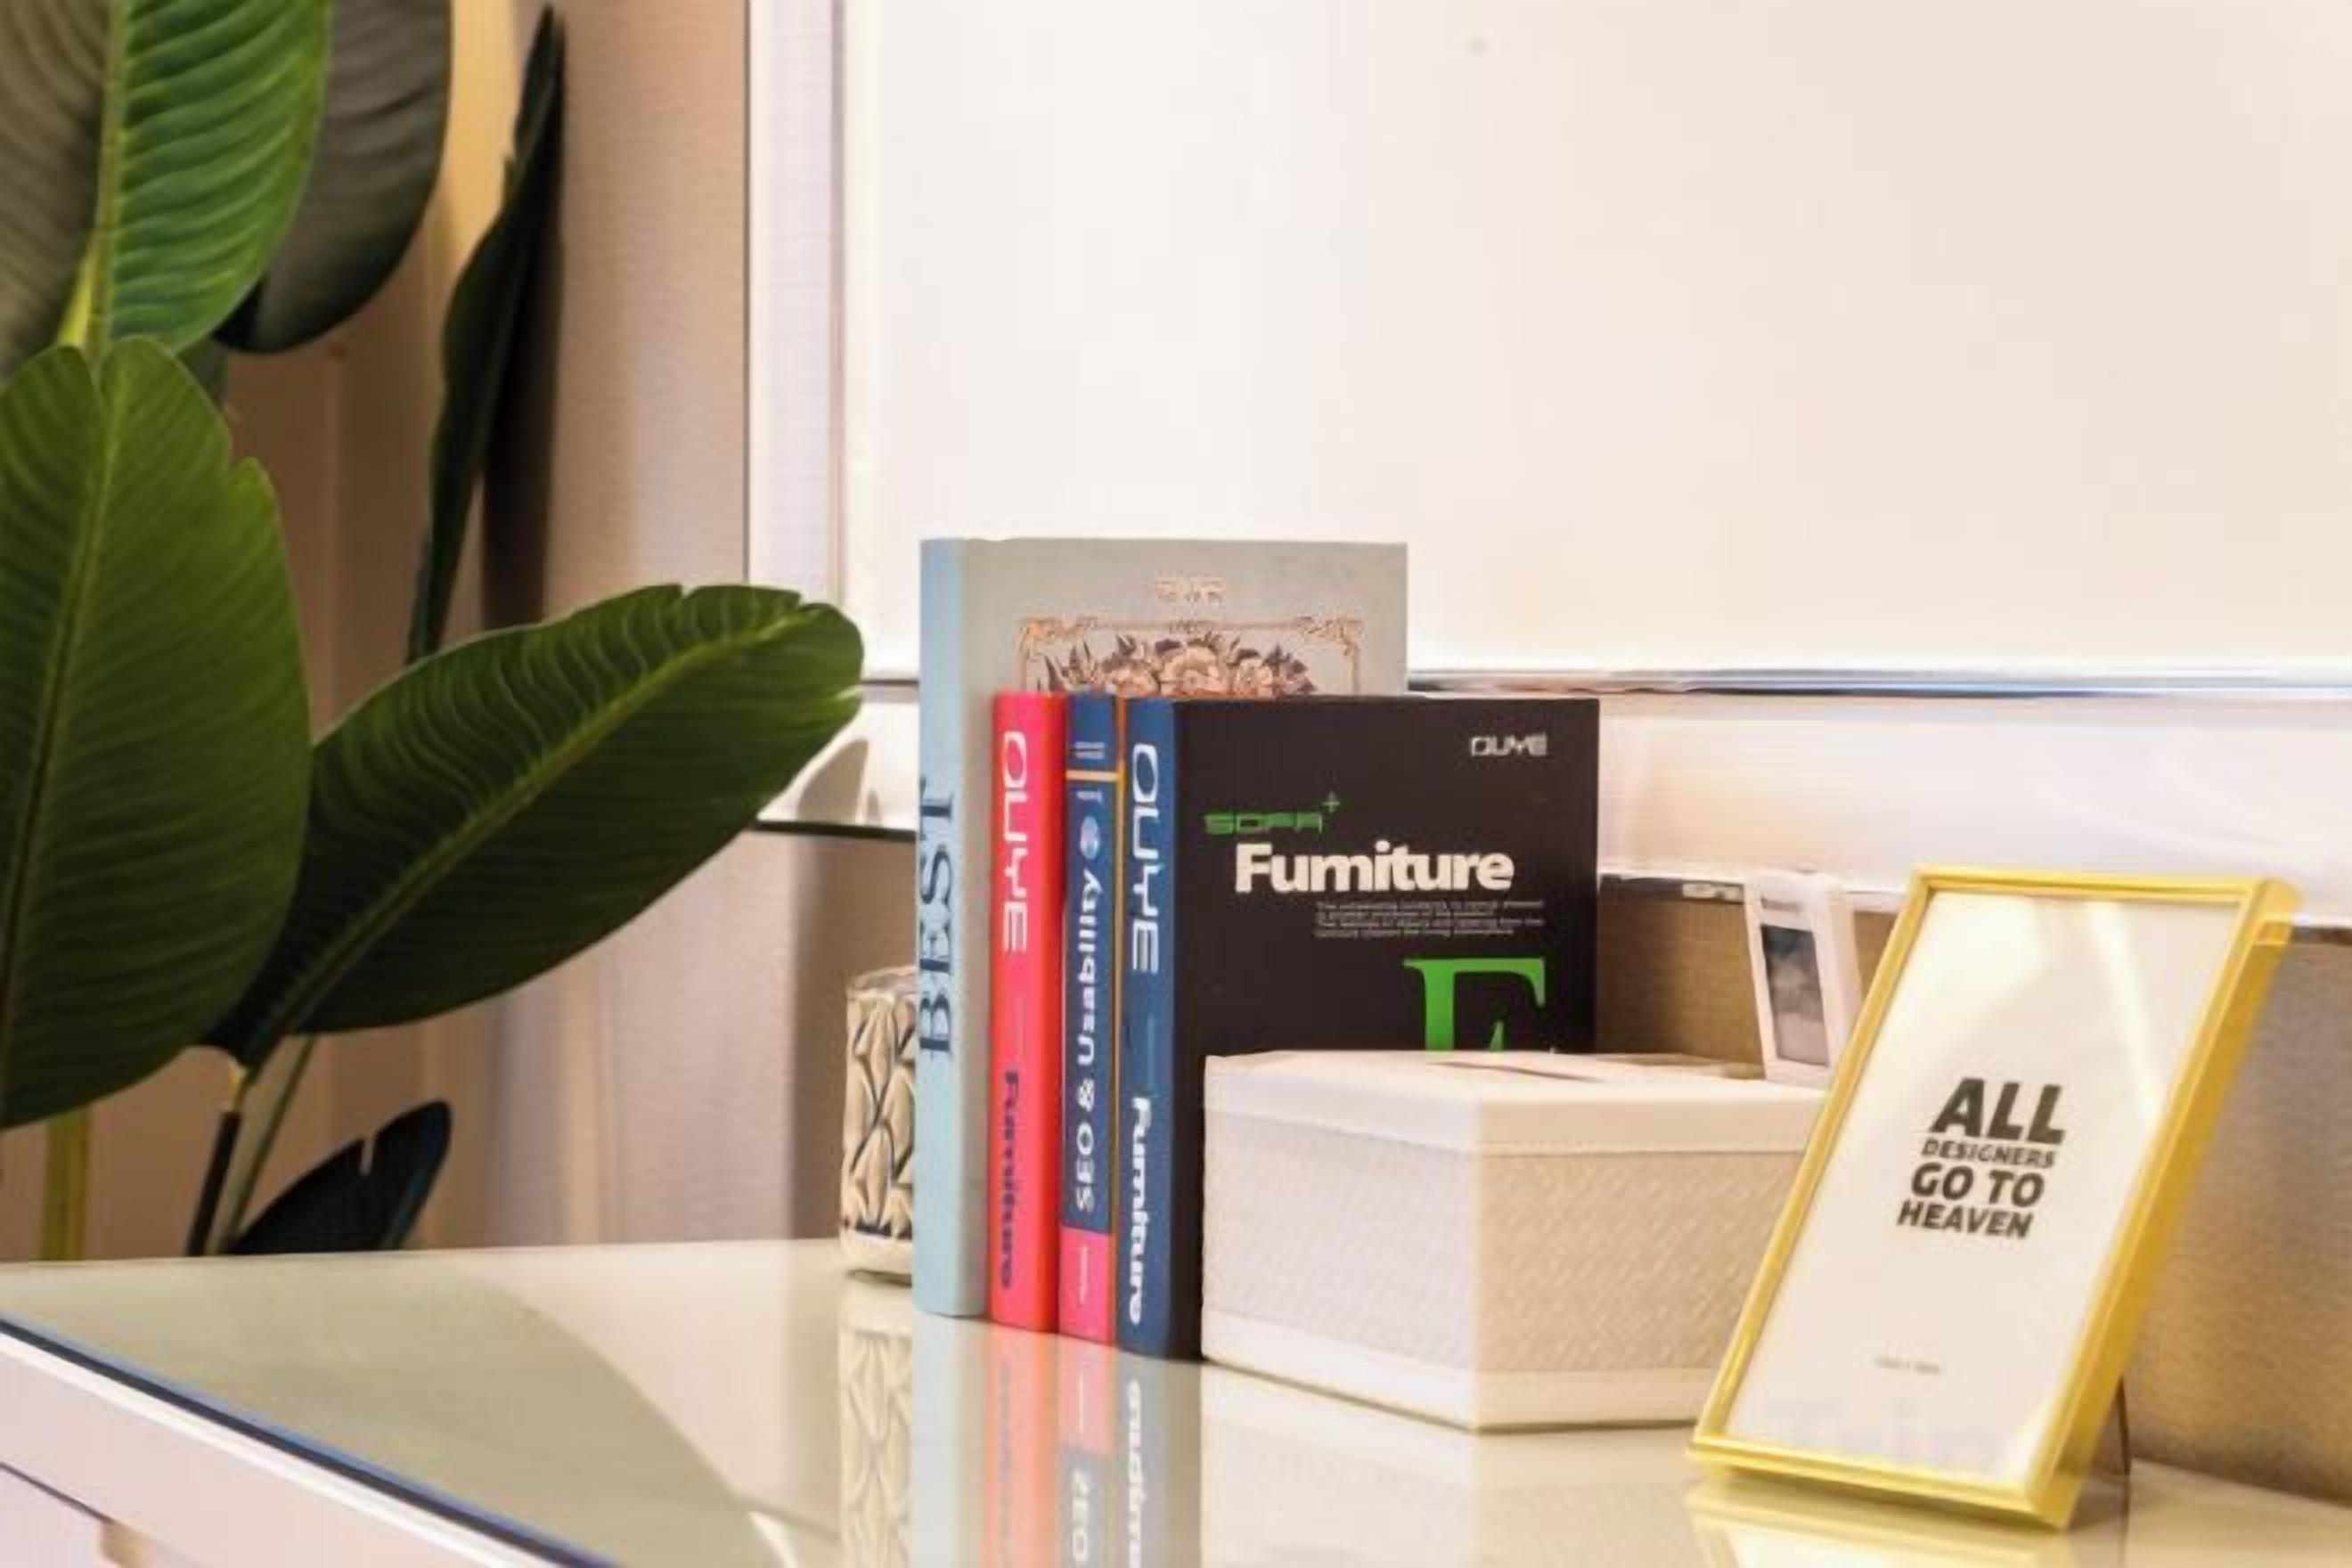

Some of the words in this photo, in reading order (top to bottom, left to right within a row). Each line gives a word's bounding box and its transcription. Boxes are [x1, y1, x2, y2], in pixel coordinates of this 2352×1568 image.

[1003, 731, 1028, 954] OUYE
[1132, 744, 1160, 973] OUYE
[1235, 839, 1515, 893] Furniture
[919, 775, 953, 1059] BEST
[1076, 868, 1103, 1066] Usability
[1077, 1077, 1095, 1113] &
[1928, 1077, 2066, 1145] ALL
[1076, 1122, 1095, 1214] SEO
[1911, 1162, 1974, 1200] GO
[1988, 1169, 2045, 1208] TO
[1922, 1137, 2055, 1169] DESIGNERS
[1897, 1199, 2034, 1239] HEAVEN
